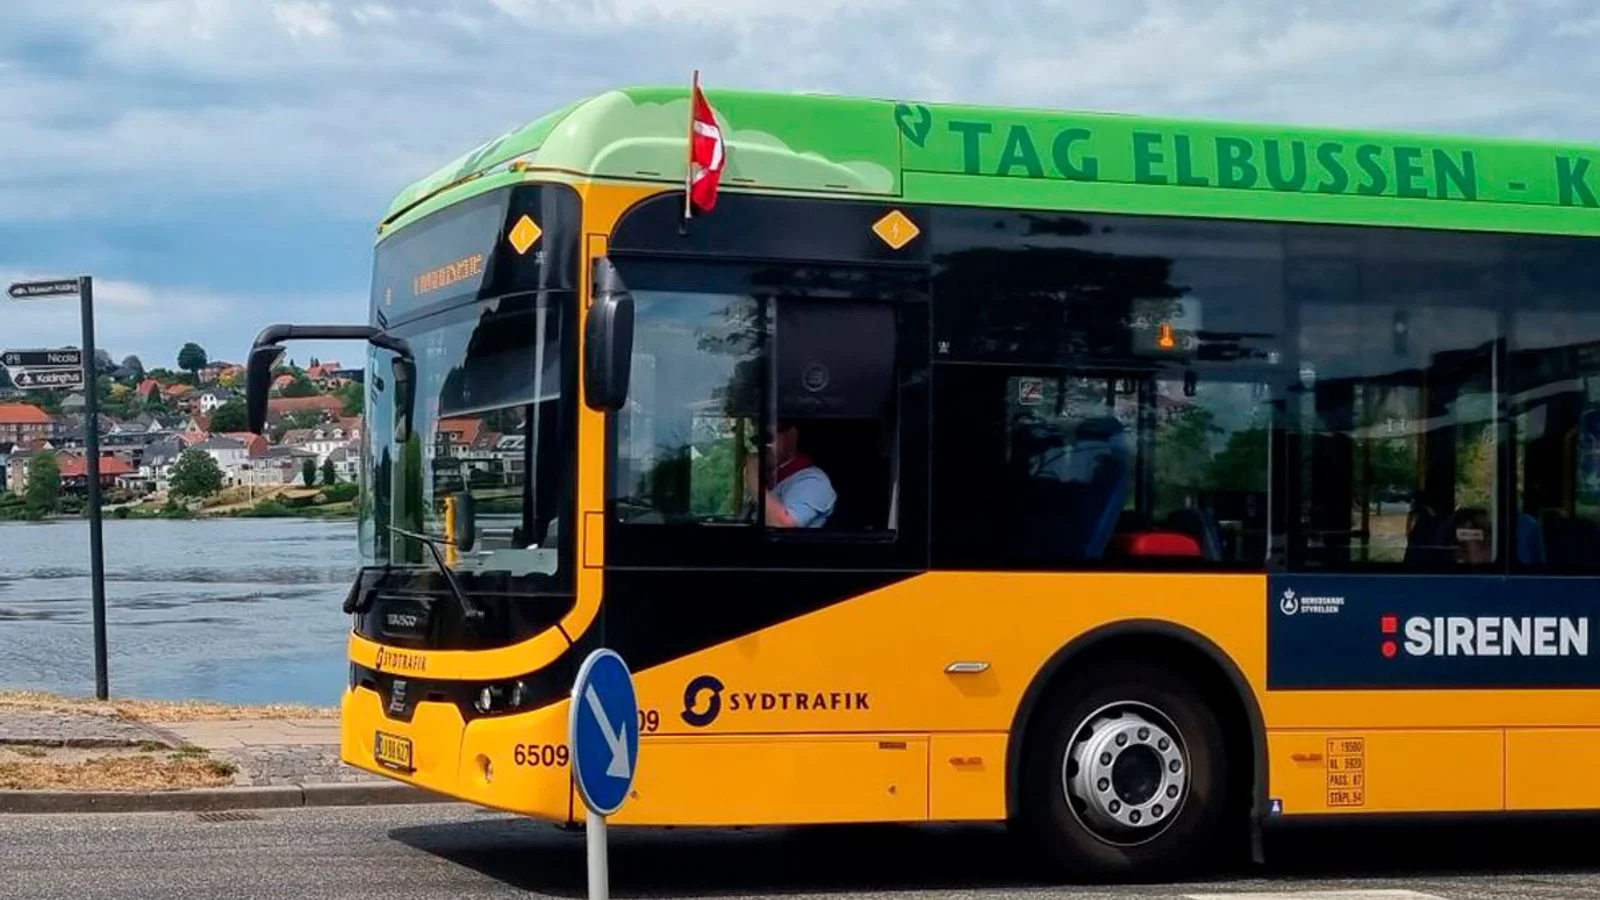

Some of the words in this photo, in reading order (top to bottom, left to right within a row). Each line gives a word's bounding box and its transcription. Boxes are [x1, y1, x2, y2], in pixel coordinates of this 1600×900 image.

[948, 121, 1099, 182] TAG
[1131, 131, 1477, 201] ELBUSSEN
[1555, 155, 1600, 208] K
[1404, 616, 1589, 656] SIRENEN
[729, 693, 870, 710] SYDTRAFIK
[514, 744, 569, 767] 6509
